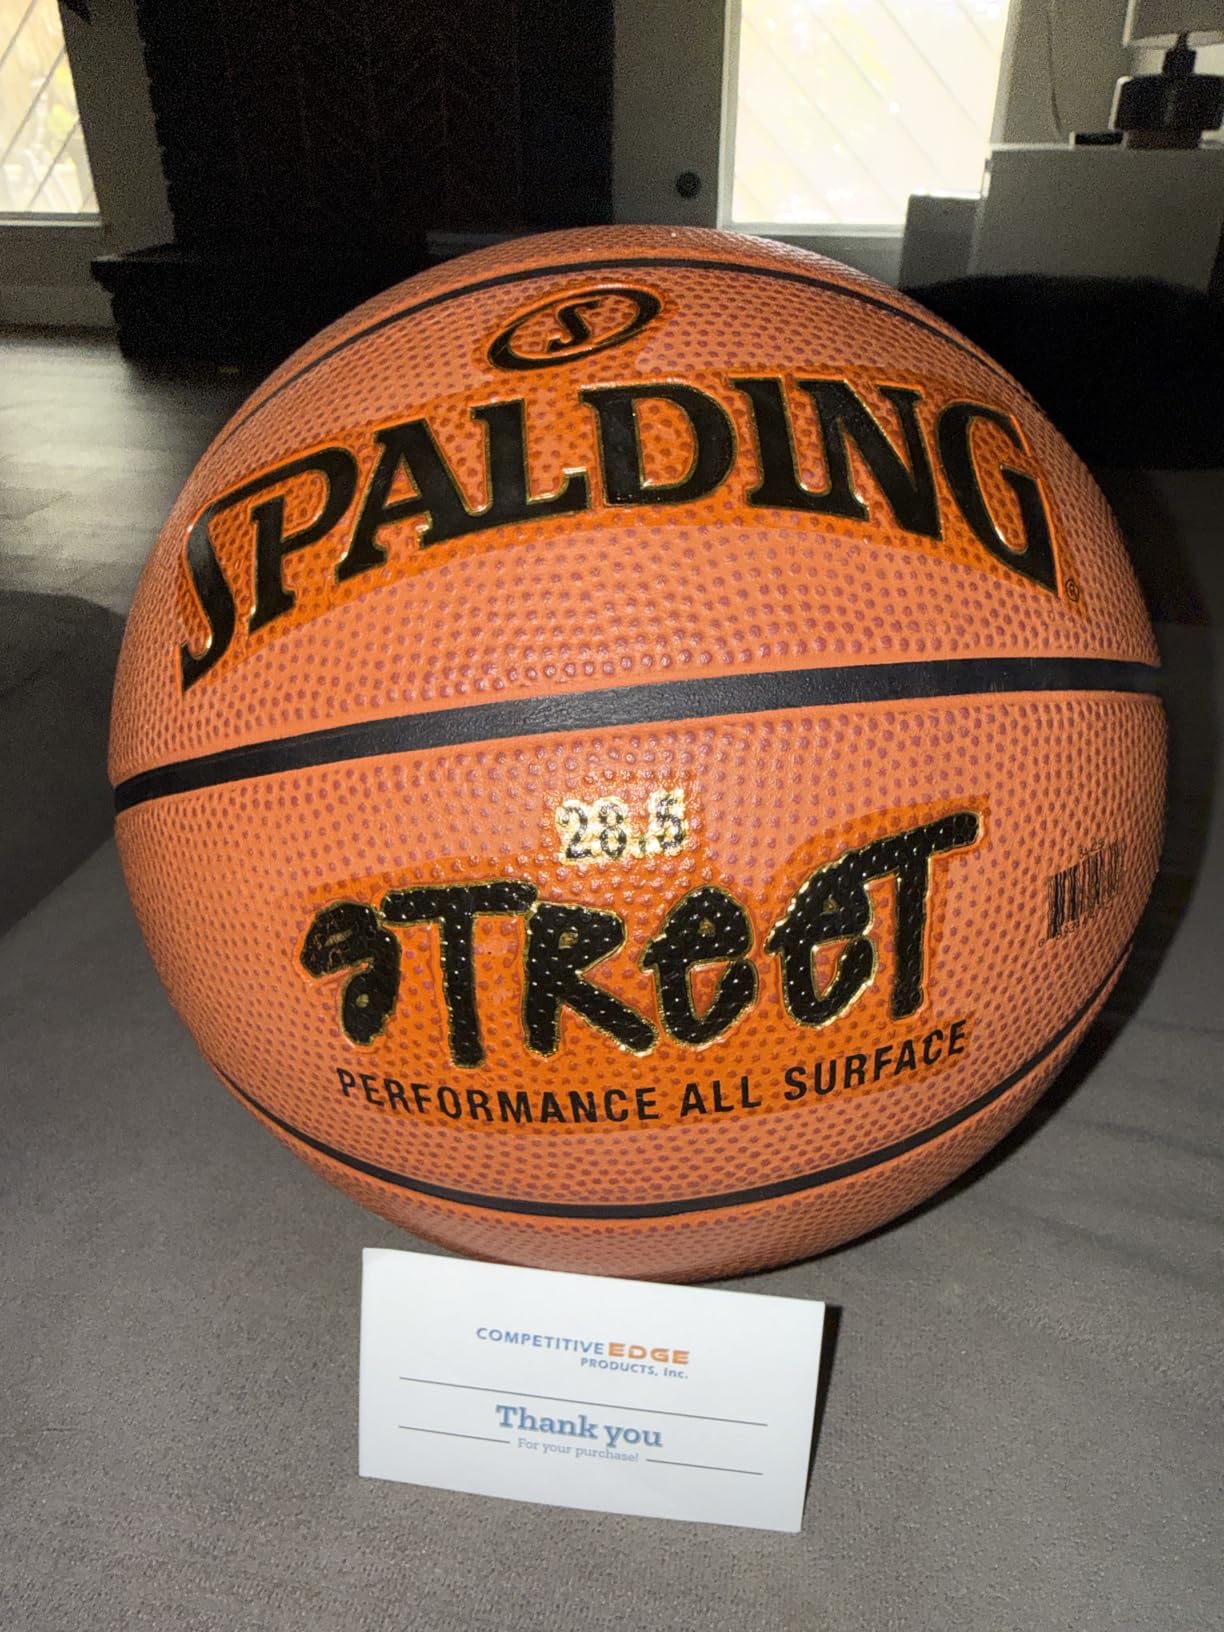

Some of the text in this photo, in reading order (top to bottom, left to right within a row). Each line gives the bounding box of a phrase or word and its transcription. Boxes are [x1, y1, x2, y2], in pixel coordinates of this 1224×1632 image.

[179, 376, 1061, 693] SPALDING
[556, 788, 688, 864] 28.5
[336, 1019, 967, 1123] PERFORMANCE ALL SURFACE
[580, 1357, 658, 1376] PRODUCTS,
[495, 1404, 663, 1449] Thank you
[517, 1437, 639, 1463] For your purchase!
